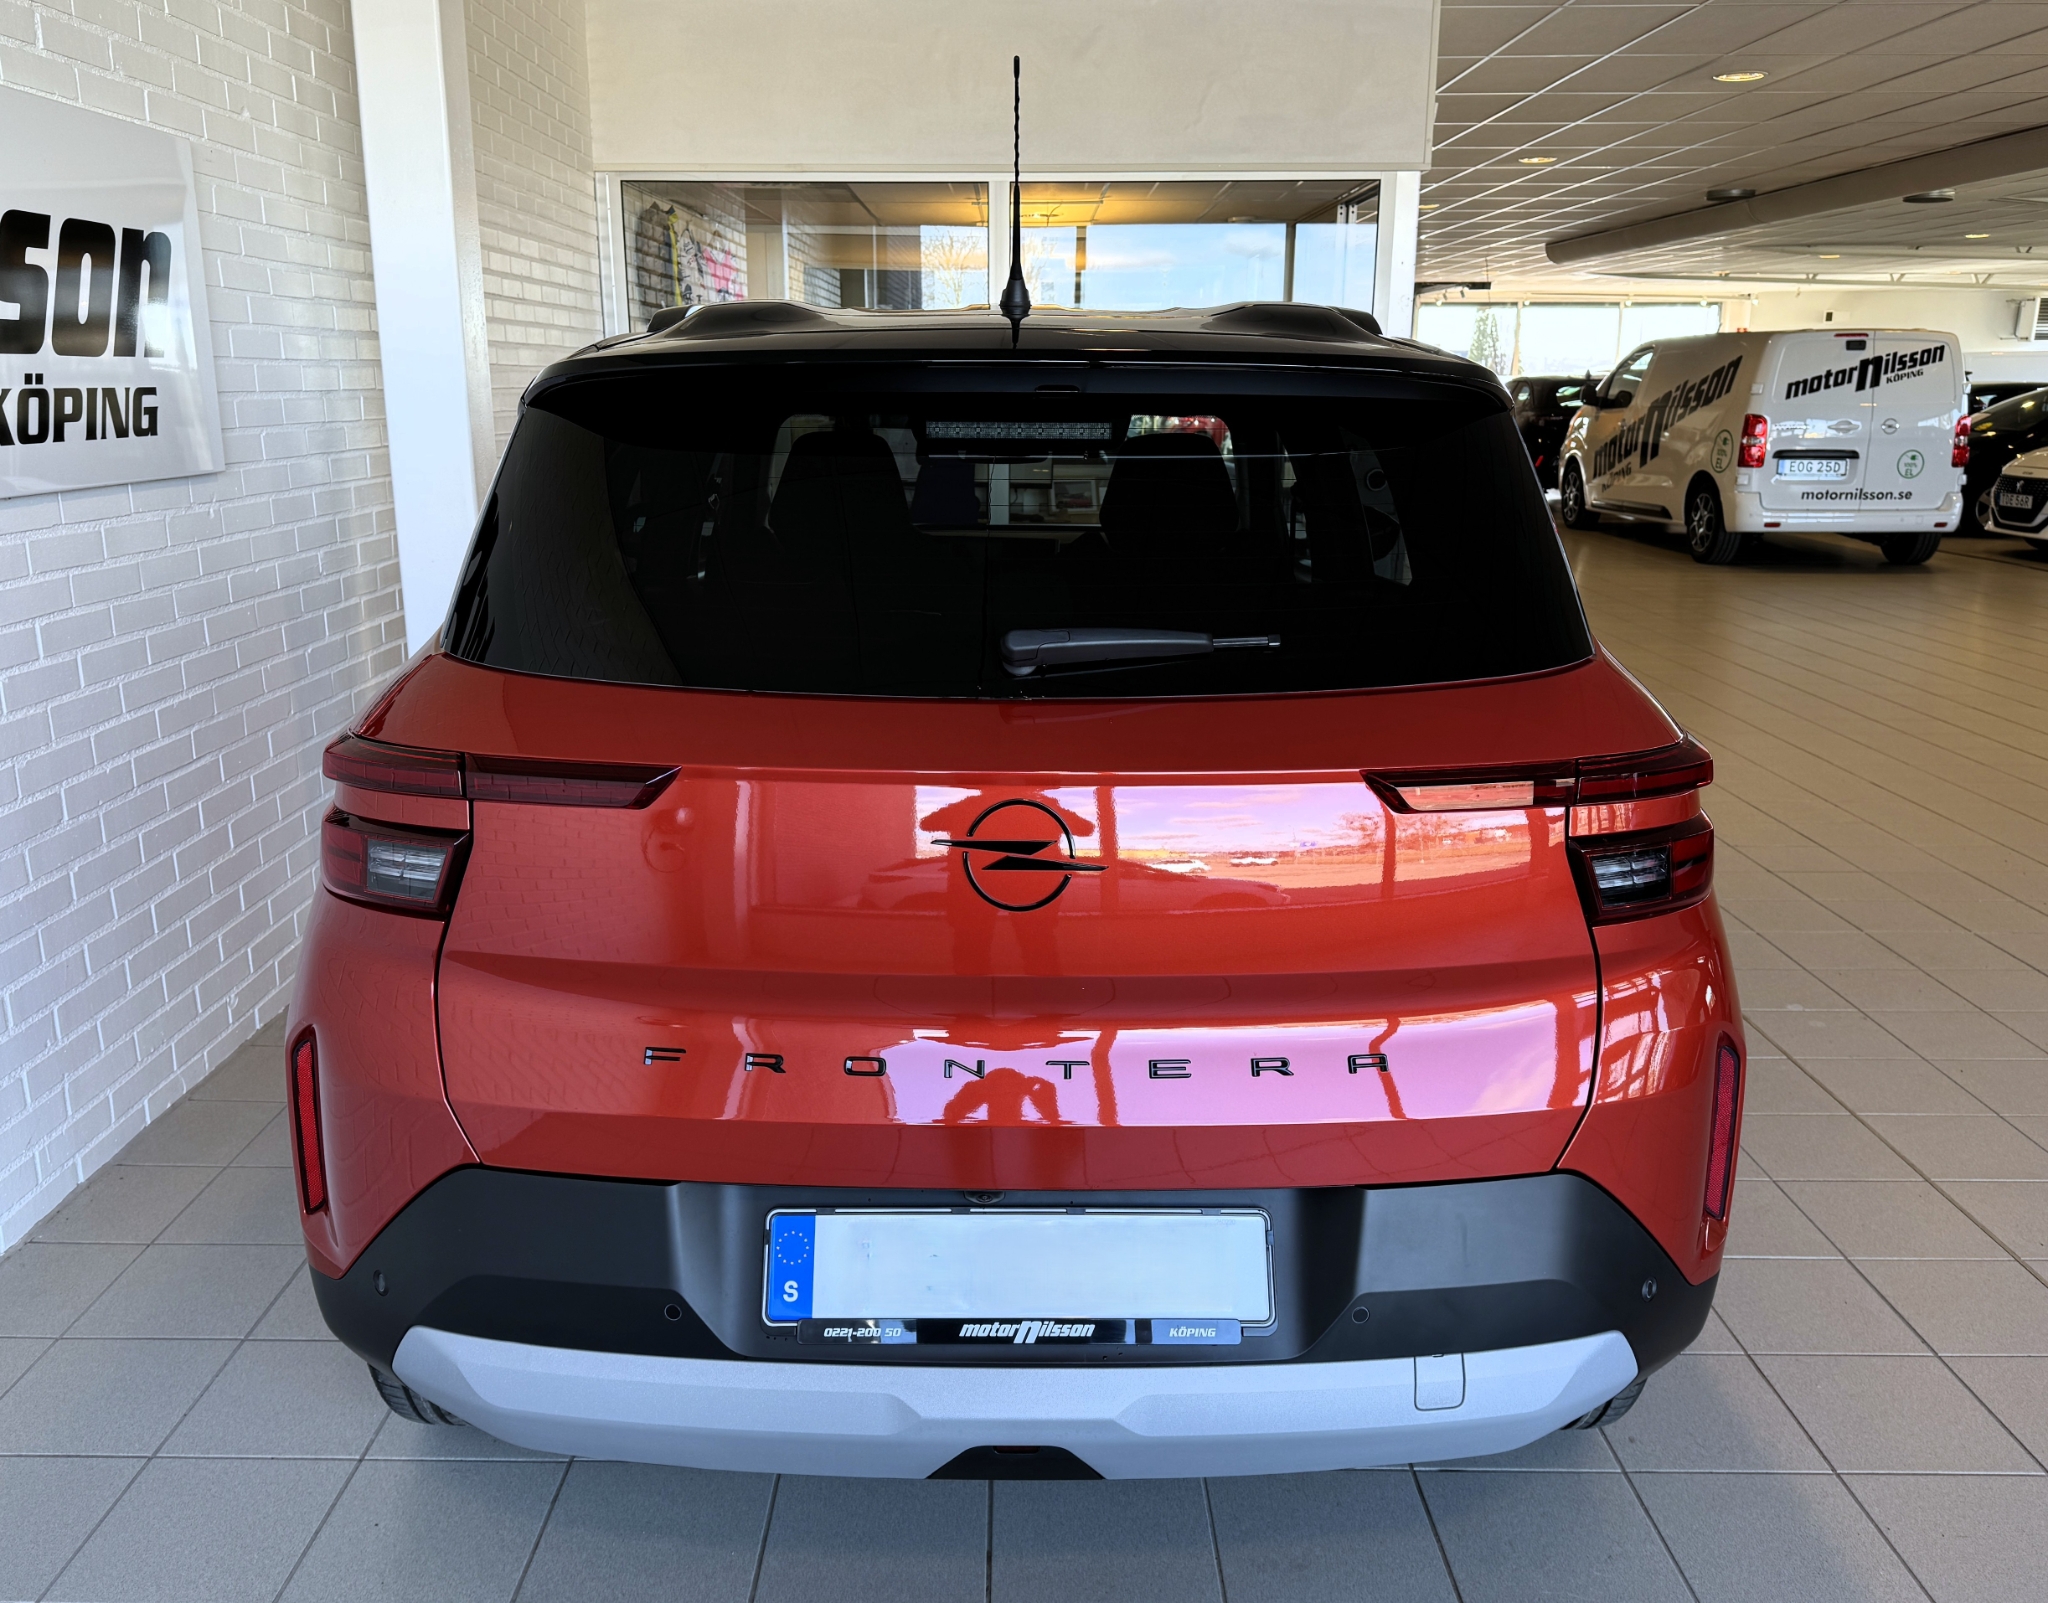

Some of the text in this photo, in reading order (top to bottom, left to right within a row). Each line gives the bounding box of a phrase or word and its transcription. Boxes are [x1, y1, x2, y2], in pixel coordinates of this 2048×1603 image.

[1886, 368, 1924, 384] KÖPING
[1789, 461, 1841, 473] EOG 25D
[1904, 468, 1914, 477] EL
[1801, 488, 1913, 501] motornilsson.se
[643, 1046, 1389, 1082] FRONTERA
[782, 1280, 799, 1303] S
[823, 1326, 902, 1338] 0221-200 50
[1168, 1325, 1217, 1338] KÖPING
